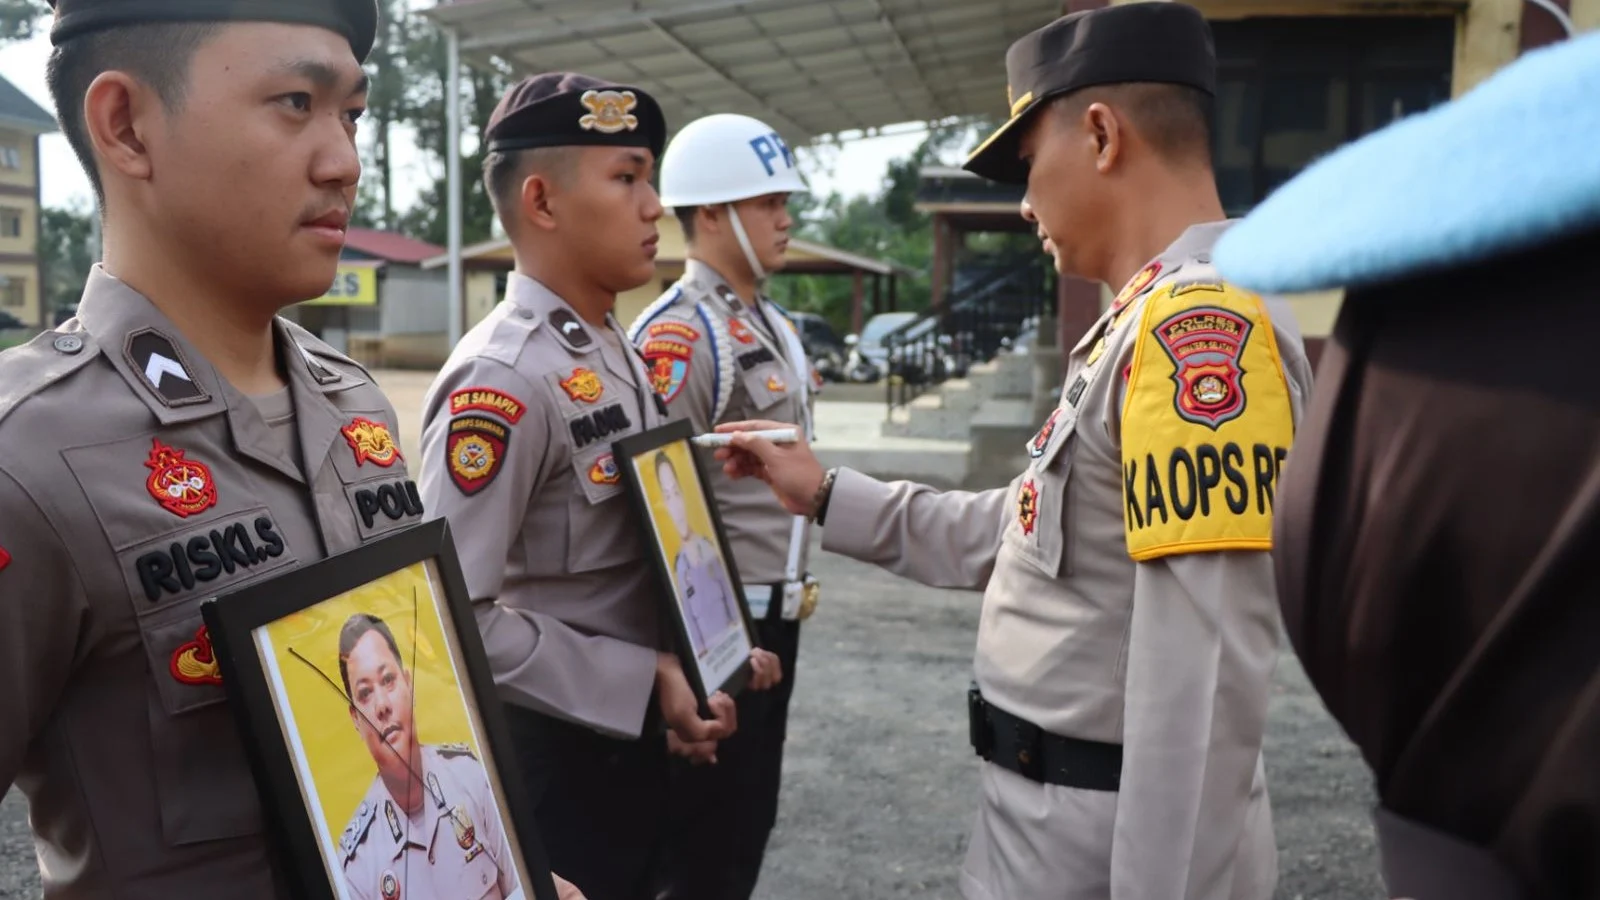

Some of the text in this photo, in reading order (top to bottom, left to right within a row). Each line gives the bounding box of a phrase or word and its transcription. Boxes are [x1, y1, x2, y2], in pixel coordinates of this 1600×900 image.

[1169, 315, 1237, 334] POLRES
[453, 391, 520, 417] SAT SAMAPTA
